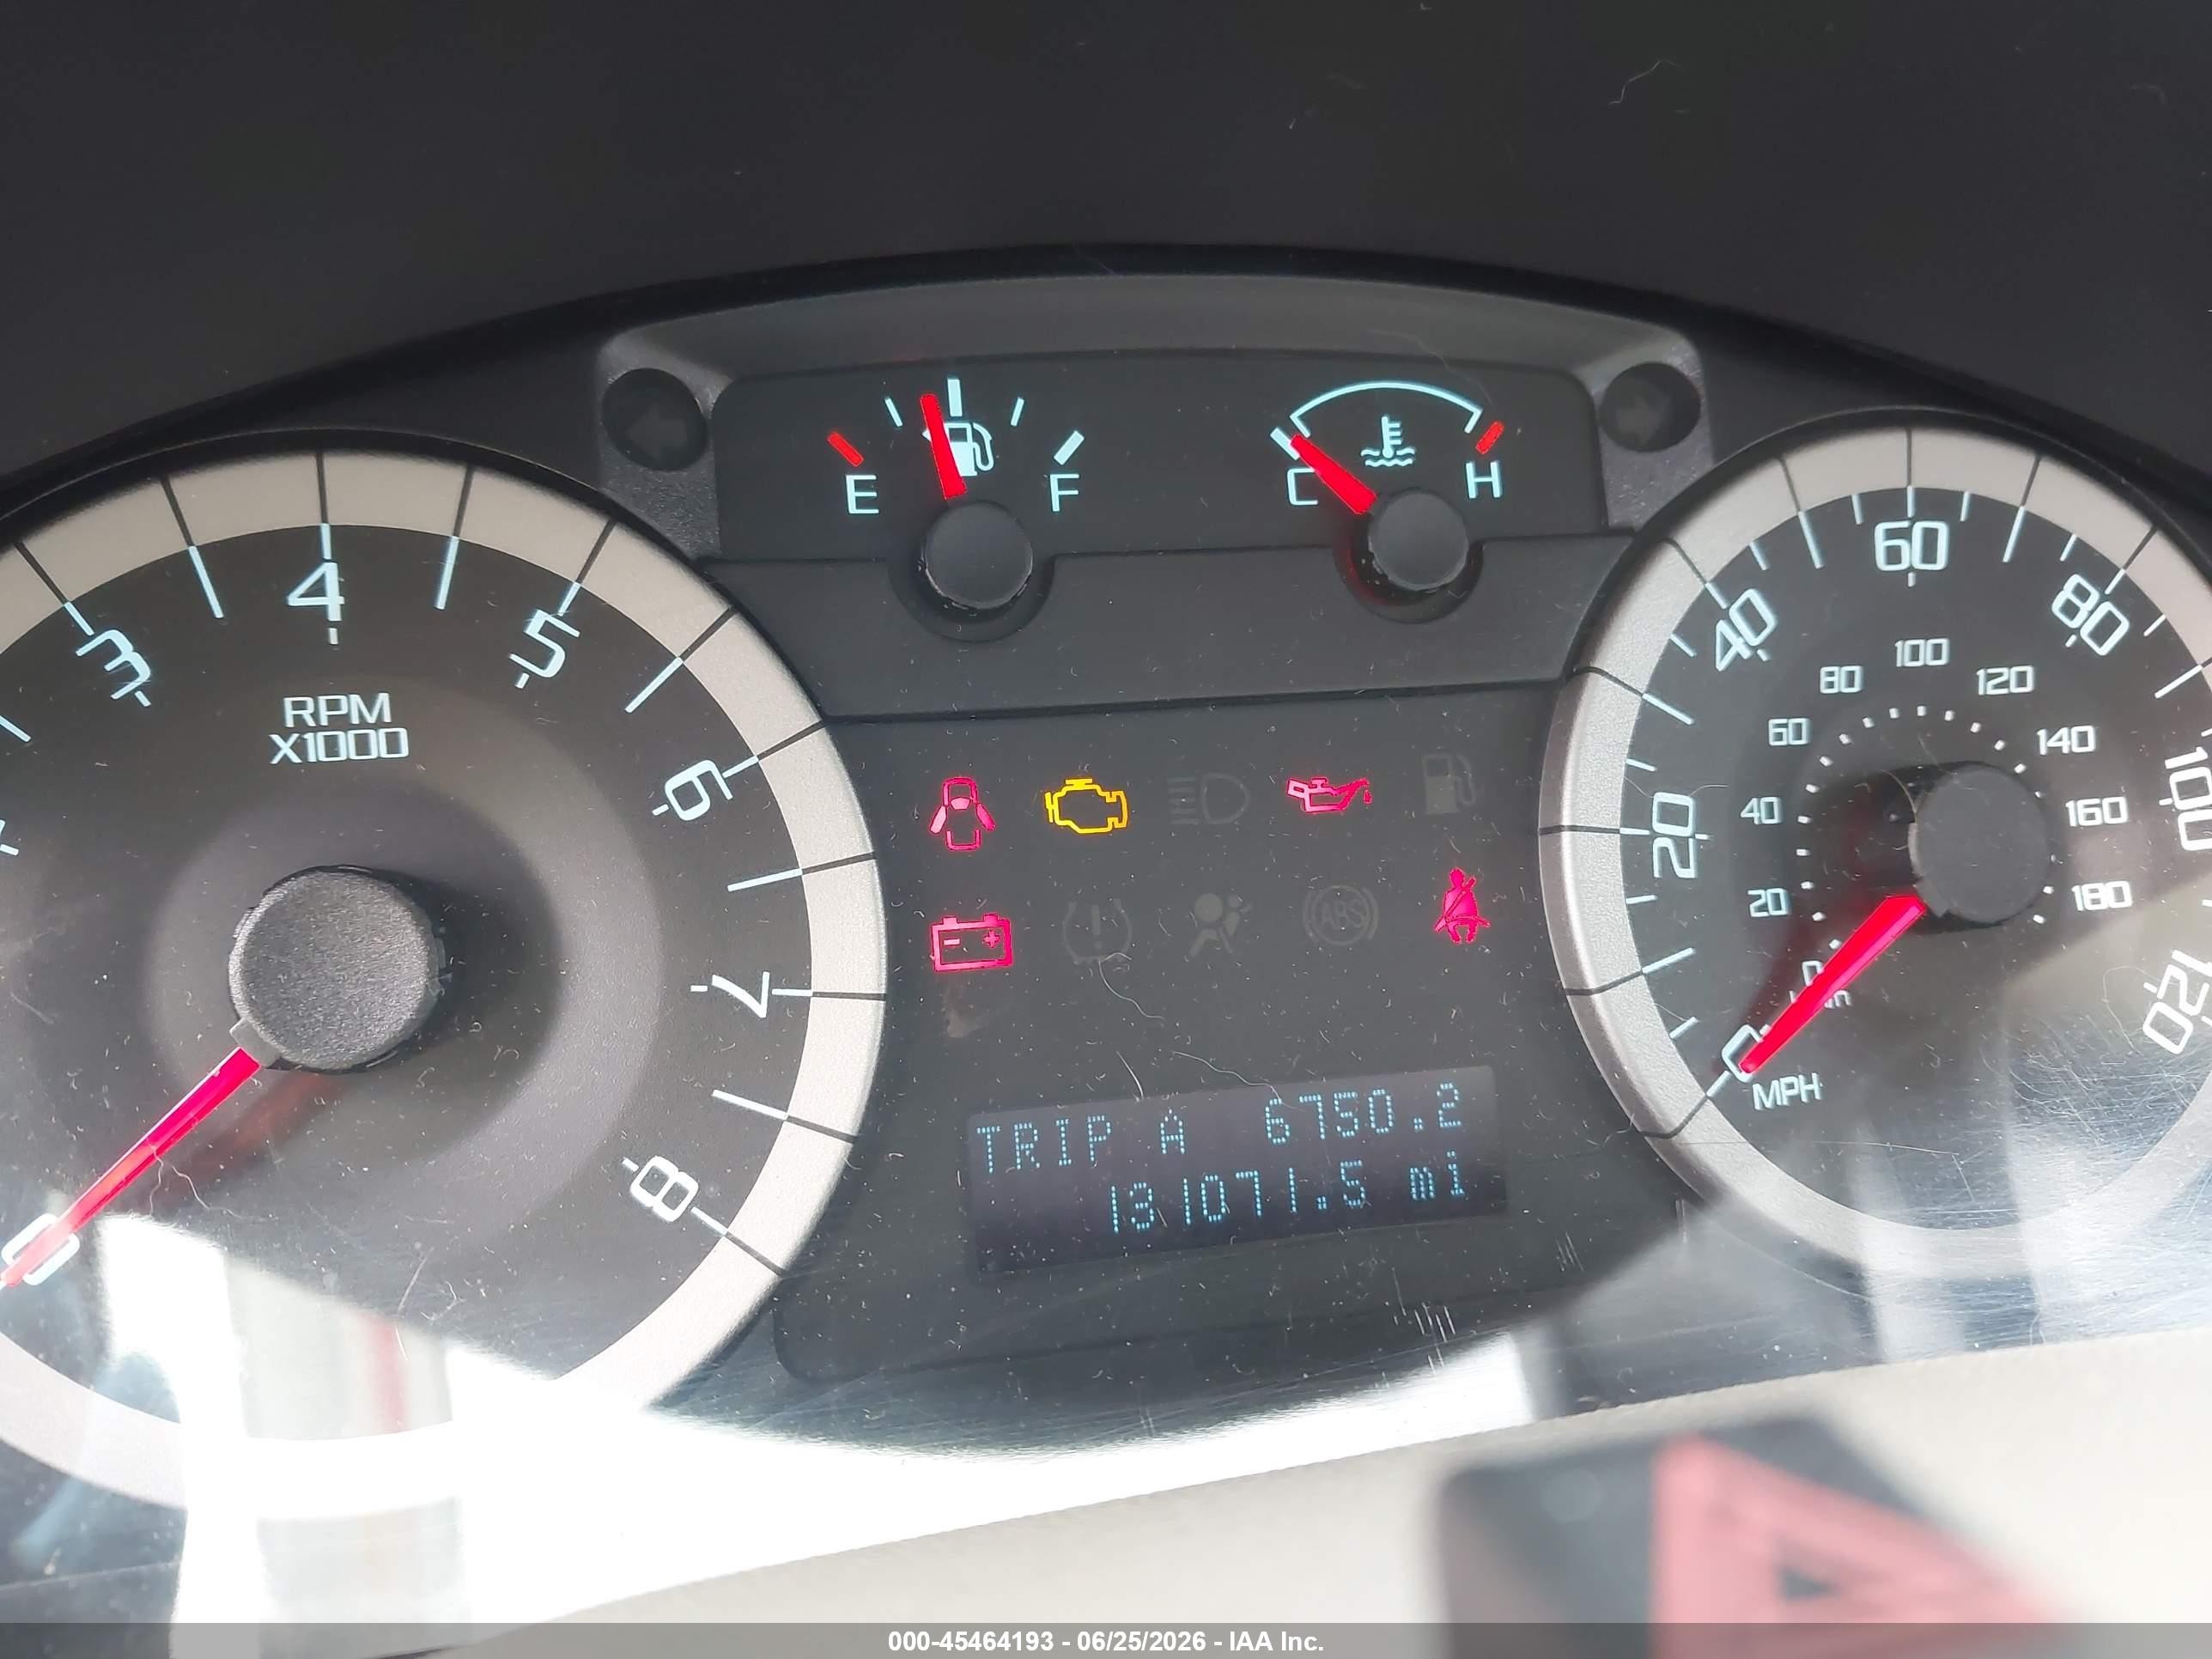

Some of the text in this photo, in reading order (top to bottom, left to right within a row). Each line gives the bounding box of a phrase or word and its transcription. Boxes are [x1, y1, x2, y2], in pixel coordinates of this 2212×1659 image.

[846, 474, 879, 514] E
[1049, 474, 1079, 513] F
[1287, 468, 1319, 506] C
[1465, 460, 1504, 500] H
[1874, 520, 1949, 571] 60
[287, 562, 344, 622] 4
[1716, 589, 1777, 672] 40
[2051, 574, 2130, 656] 80
[509, 609, 580, 678] 5
[1894, 637, 1950, 667] 100
[76, 629, 151, 700] 3
[1820, 665, 1863, 694] 80
[1976, 665, 2034, 695] 120
[283, 692, 392, 728] RPM
[269, 726, 410, 764] X1000
[1768, 718, 1809, 746] 60
[2037, 725, 2096, 755] 140
[665, 759, 733, 822] 6
[1741, 796, 1781, 825] 40
[2164, 746, 2212, 852] 100
[2065, 796, 2128, 827] 160
[1652, 792, 1698, 879] 20
[1748, 887, 1790, 917] 20
[2071, 880, 2133, 912] 180
[711, 971, 770, 1018] 7
[2143, 950, 2212, 1054] 120
[1753, 1073, 1821, 1110] MPH
[976, 1082, 1462, 1173] TRIP A 6750.2
[629, 1155, 699, 1223] 8
[1111, 1151, 1464, 1233] 131071.5 mi
